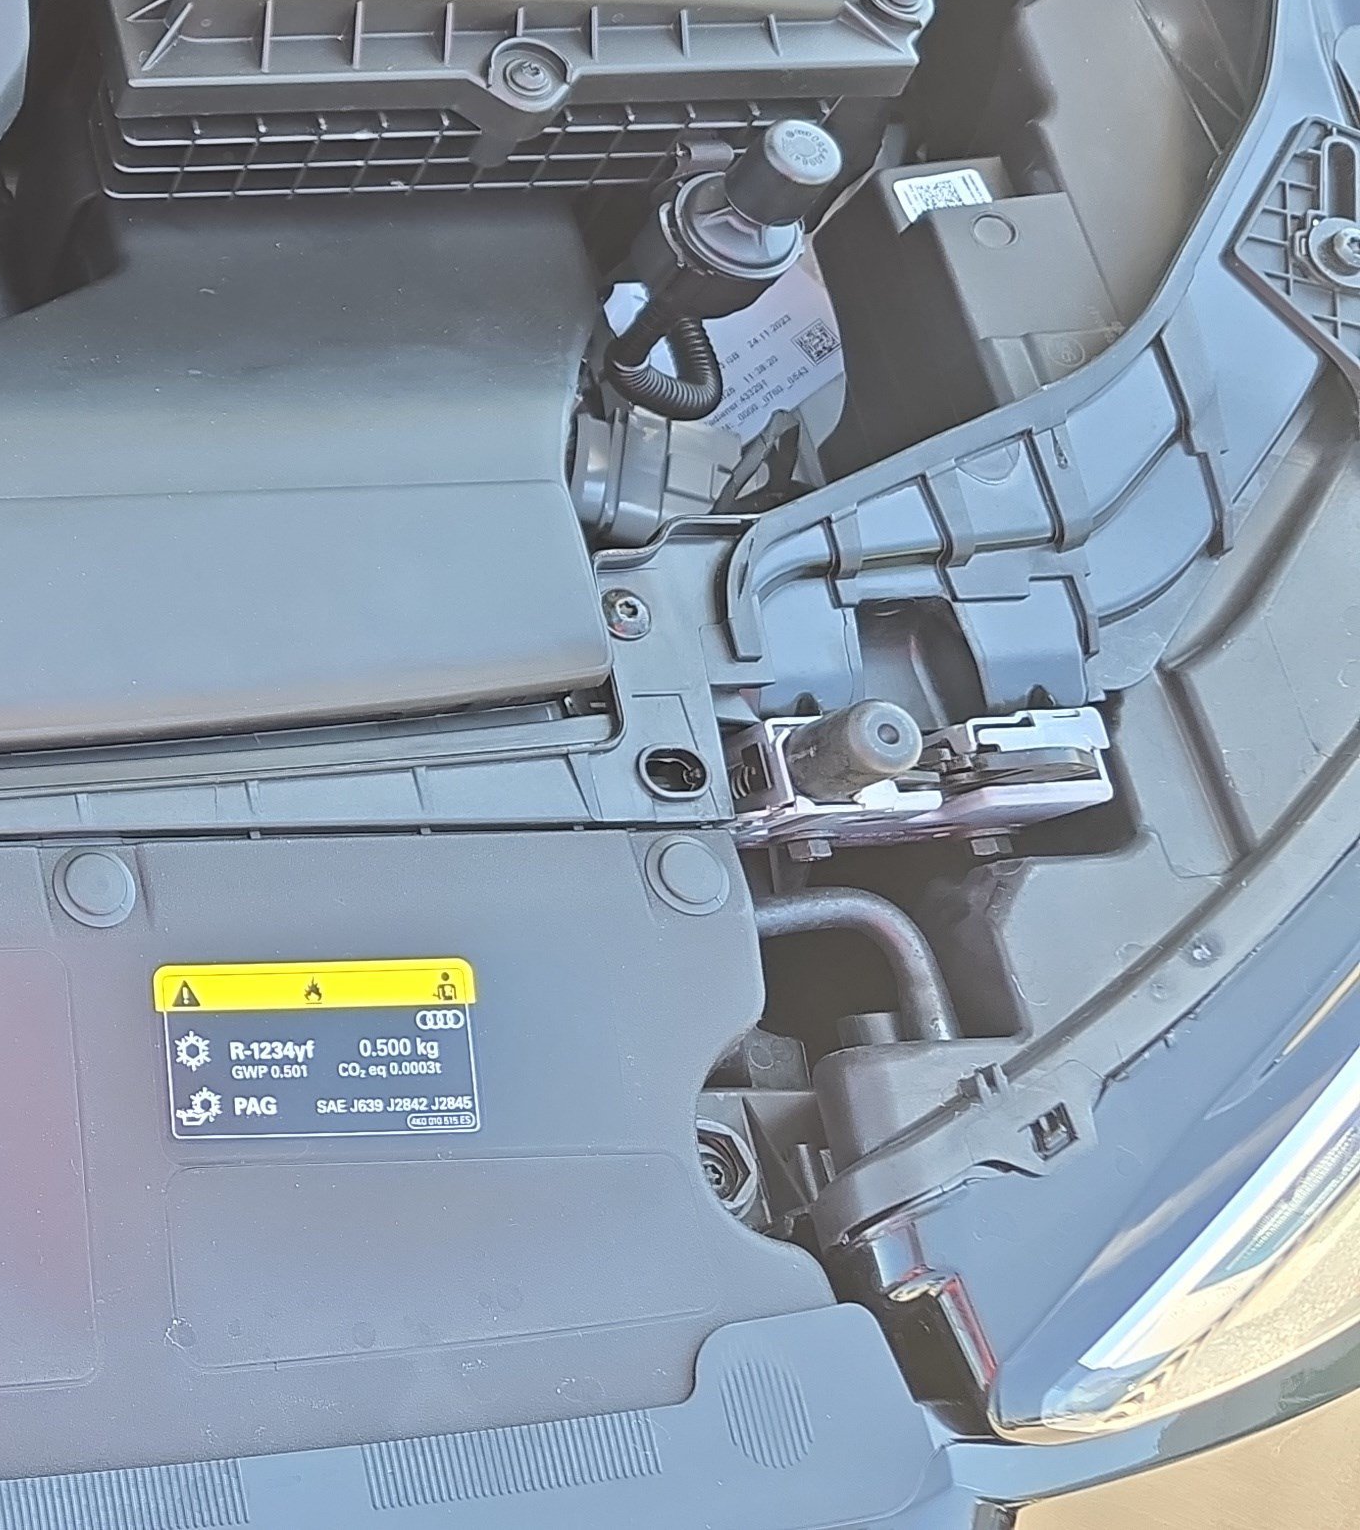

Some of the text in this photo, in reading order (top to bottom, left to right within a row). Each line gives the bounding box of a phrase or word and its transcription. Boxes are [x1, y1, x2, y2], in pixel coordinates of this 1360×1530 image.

[229, 1039, 316, 1063] R-1234yf
[358, 1037, 440, 1059] 0.500 kg
[231, 1064, 309, 1080] GWP 0.501
[368, 1065, 387, 1079] eq
[389, 1060, 442, 1076] 0.0003t
[233, 1095, 279, 1116] PAG
[315, 1095, 473, 1114] SAE J639 J2842 J2845
